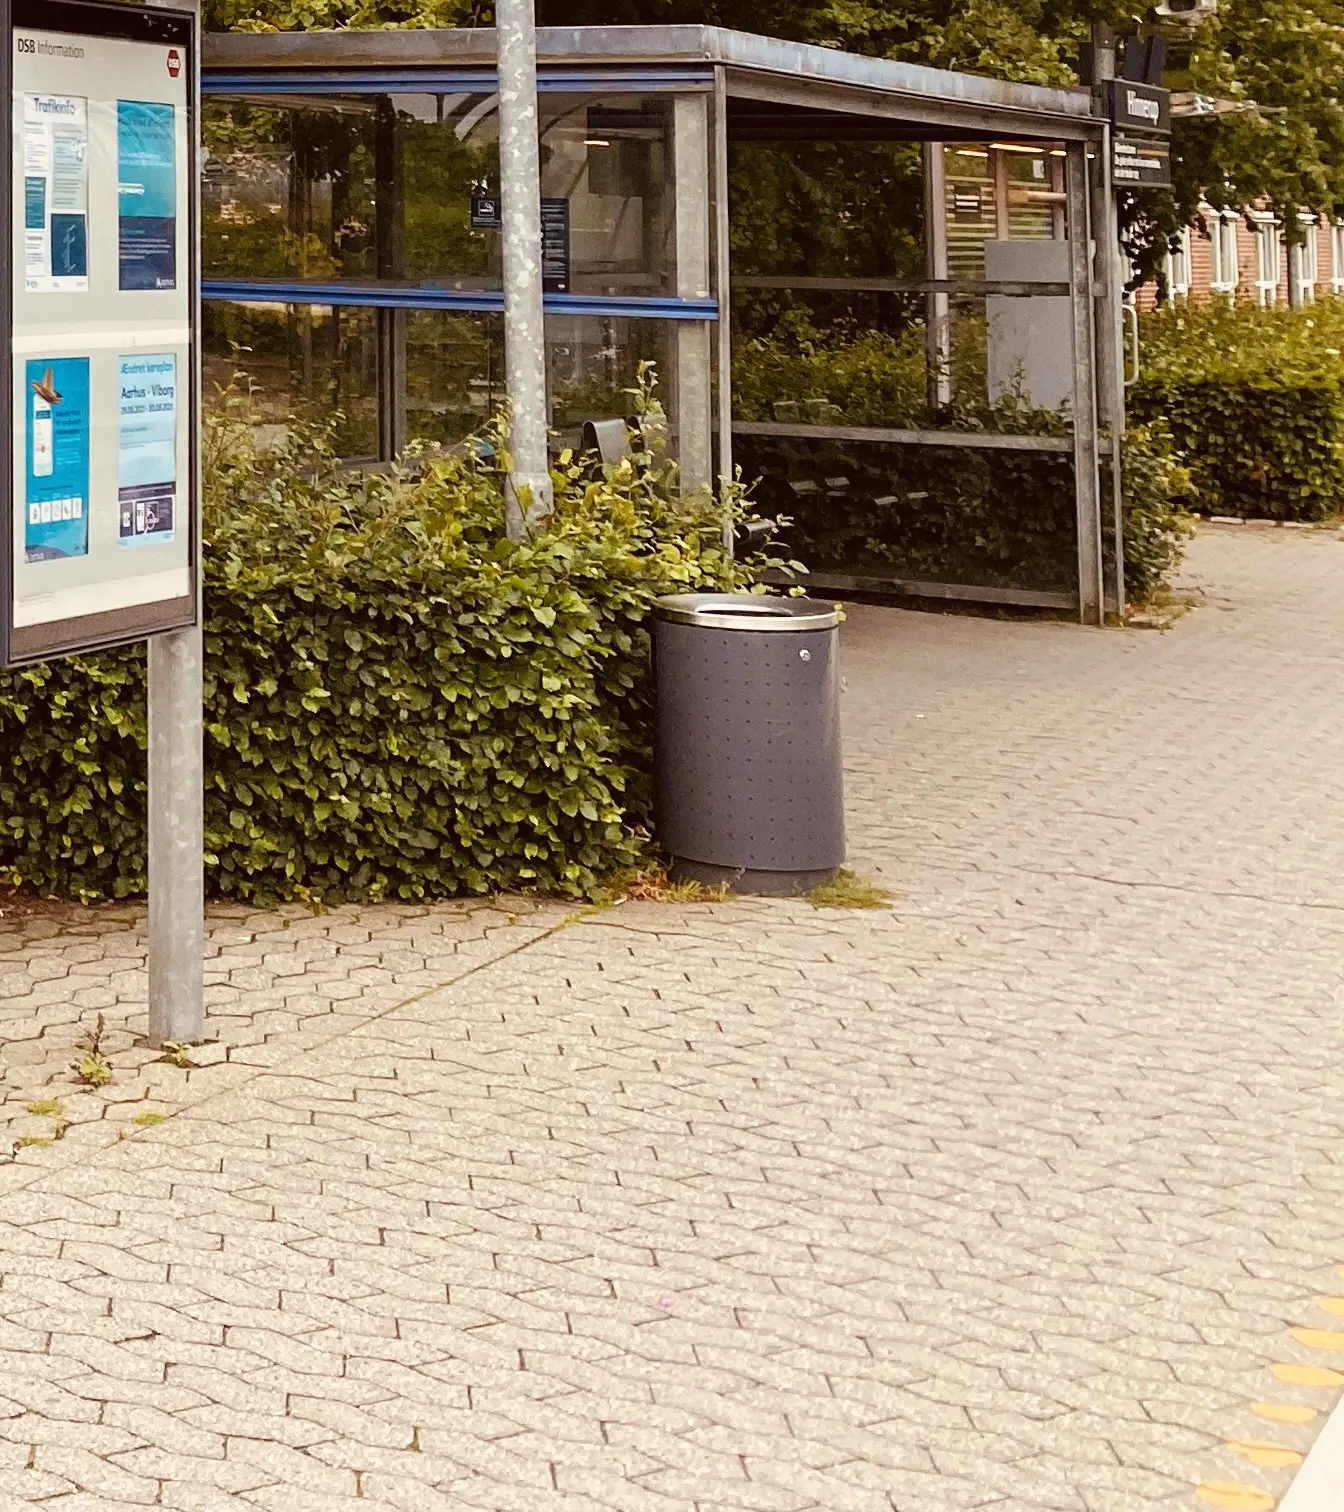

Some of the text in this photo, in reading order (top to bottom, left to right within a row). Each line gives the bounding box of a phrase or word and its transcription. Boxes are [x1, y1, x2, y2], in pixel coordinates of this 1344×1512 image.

[17, 38, 85, 59] DSB Information
[120, 386, 146, 399] Aarhus
[151, 384, 174, 399] Viborg
